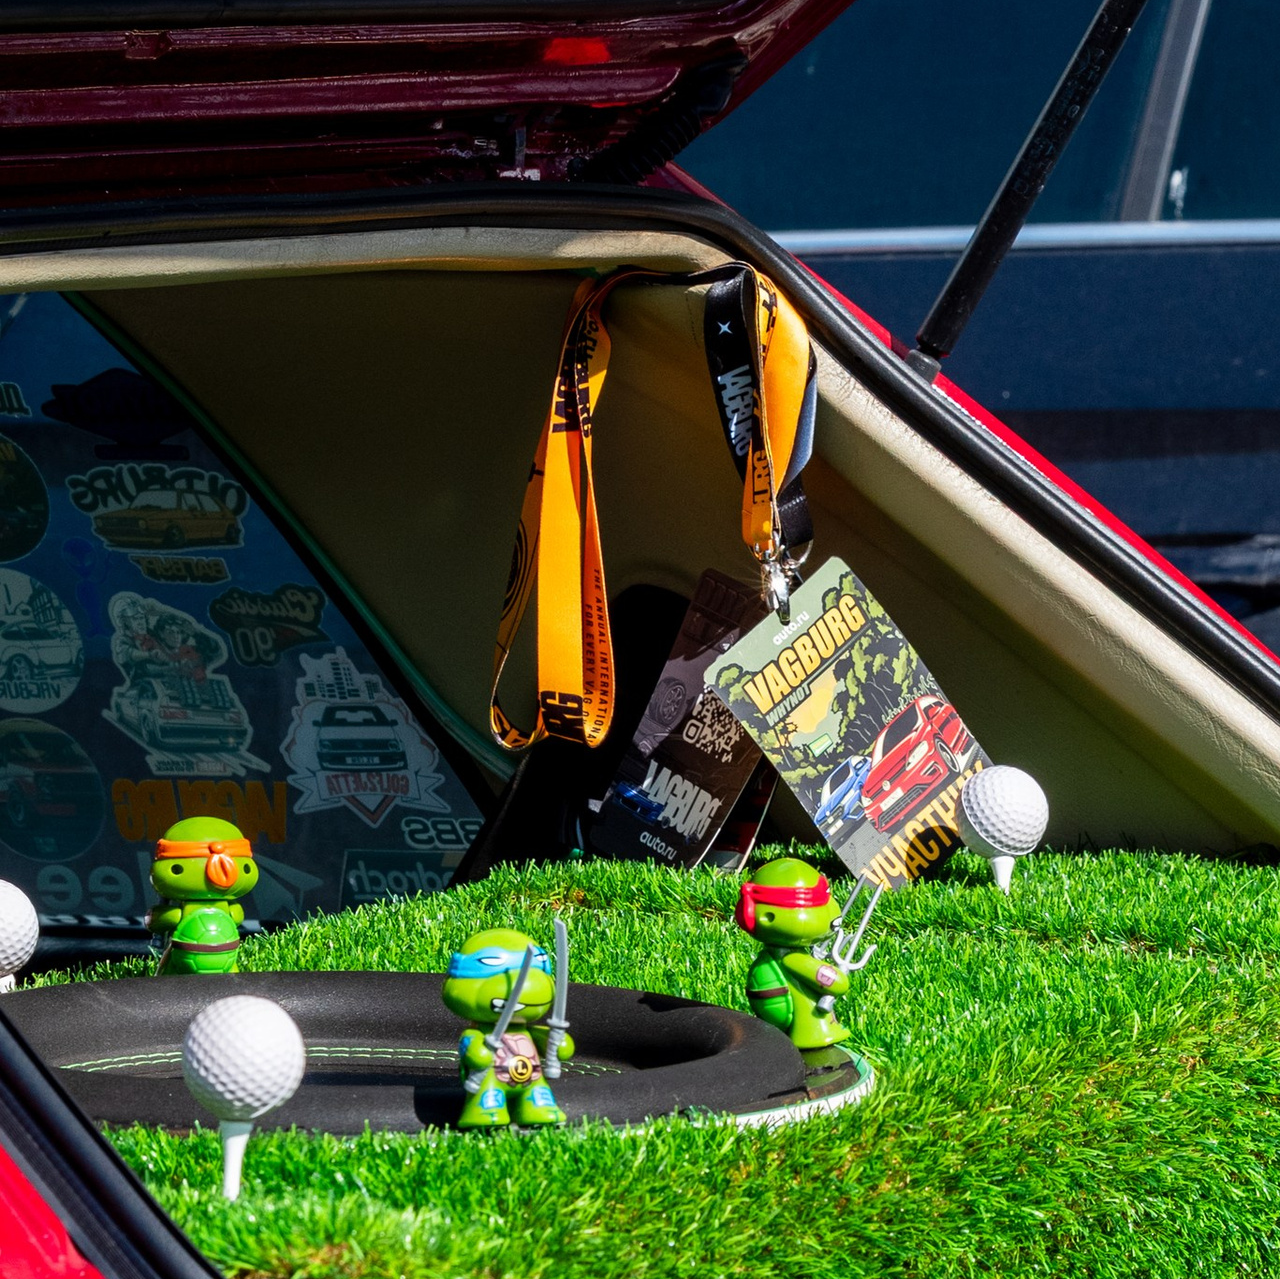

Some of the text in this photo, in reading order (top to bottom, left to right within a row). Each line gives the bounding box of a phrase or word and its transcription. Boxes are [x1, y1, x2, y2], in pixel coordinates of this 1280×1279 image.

[593, 569, 602, 590] THE
[585, 604, 594, 627] FOR
[595, 597, 607, 644] ANNUAL
[772, 610, 810, 646] auto.ru
[584, 633, 595, 674] EVERY
[743, 594, 866, 714] VAGBURG
[583, 680, 595, 704] VAG
[765, 682, 811, 727] WHYNOT
[645, 759, 722, 840] VAGBURG
[639, 830, 677, 860] auto.ru
[861, 760, 984, 892] УЧАСТН
